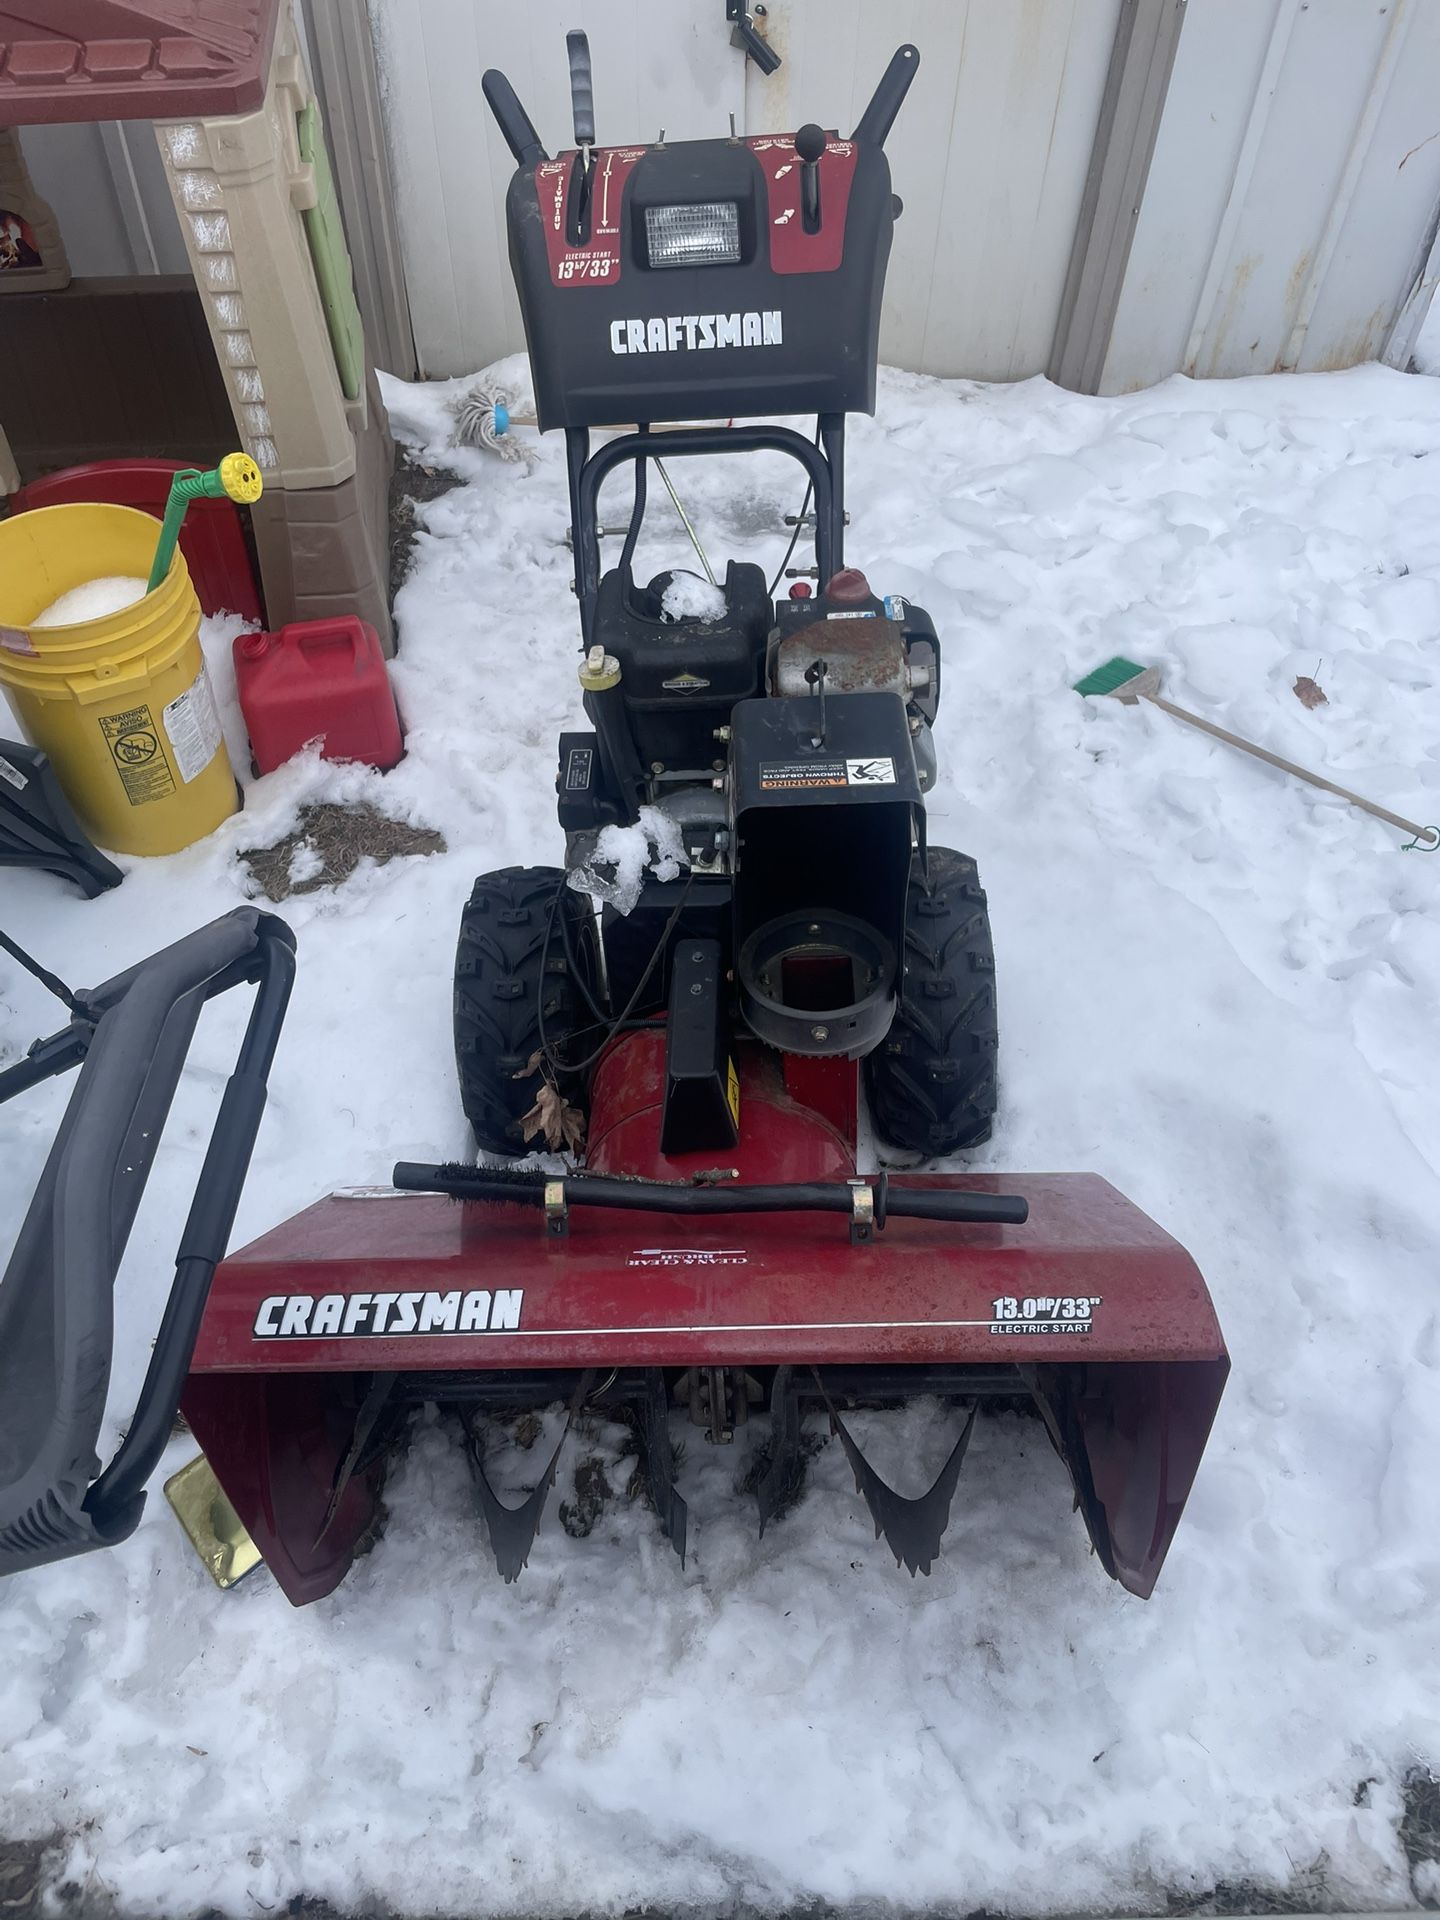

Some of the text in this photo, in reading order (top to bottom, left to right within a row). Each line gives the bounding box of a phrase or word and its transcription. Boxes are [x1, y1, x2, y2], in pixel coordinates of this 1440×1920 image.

[565, 251, 611, 260] ELECTRIC START
[610, 311, 782, 354] CRAFTSMAN
[110, 707, 146, 723] WARNING
[120, 715, 143, 727] AVISO
[765, 779, 830, 787] WARNING
[254, 1290, 524, 1336] CRAFTSMAN
[990, 1324, 1090, 1333] ELECTRIC START
